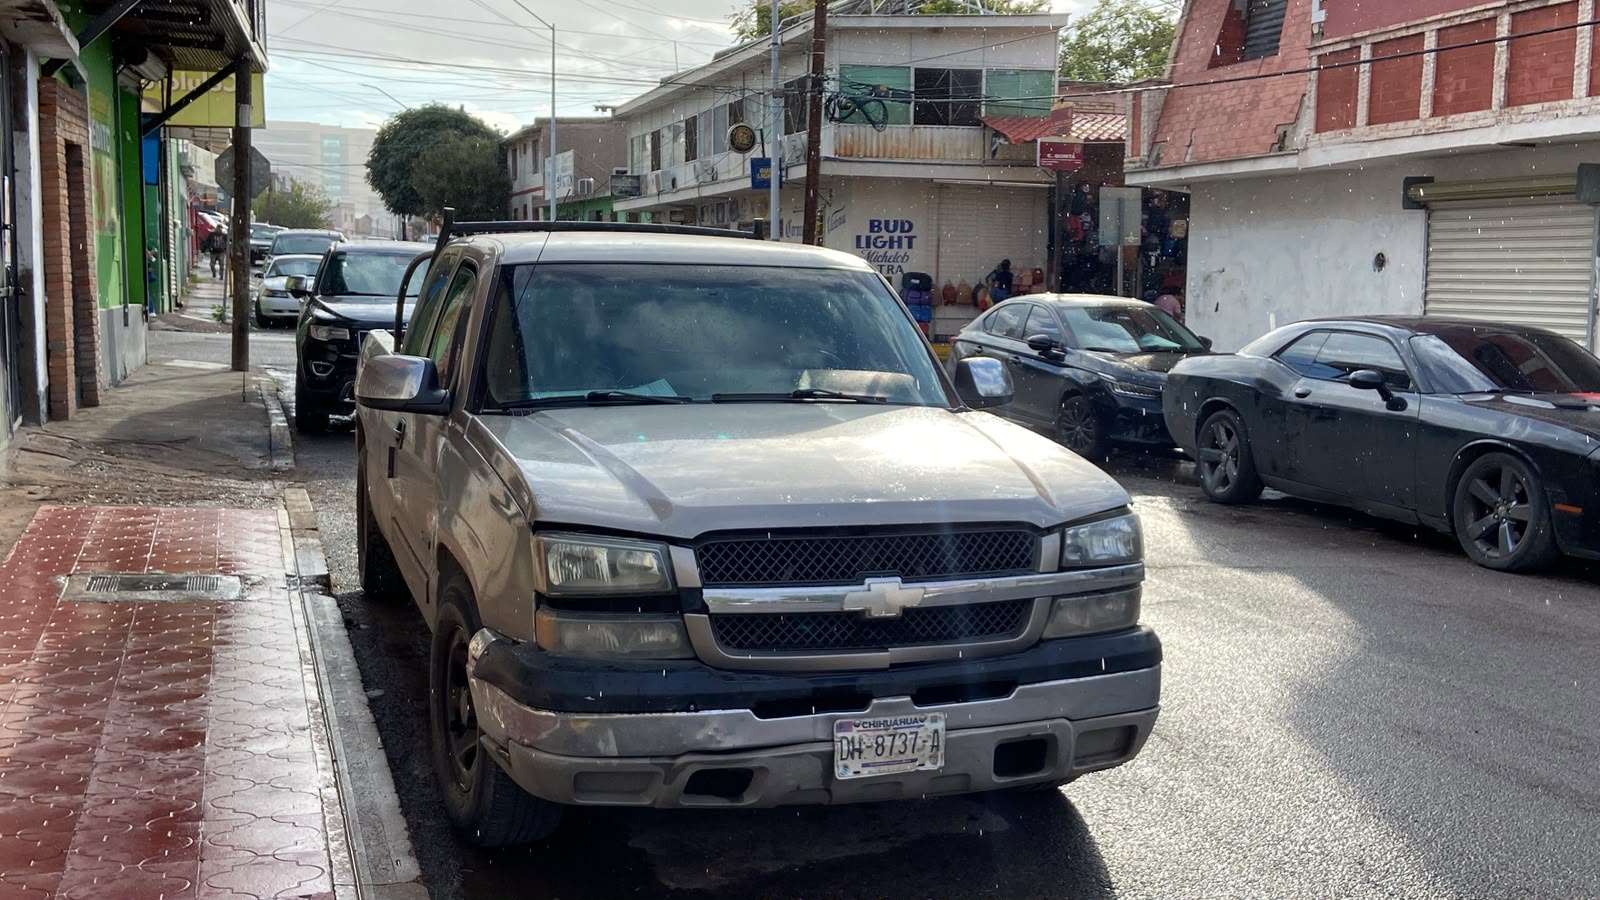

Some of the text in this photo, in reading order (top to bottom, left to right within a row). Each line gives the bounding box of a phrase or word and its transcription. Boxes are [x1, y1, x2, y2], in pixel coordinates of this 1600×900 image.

[869, 219, 914, 233] BUD
[855, 235, 917, 249] LIGHT
[861, 249, 910, 264] Michelob
[876, 264, 904, 275] TRA
[861, 717, 920, 728] CHIHUAHUA
